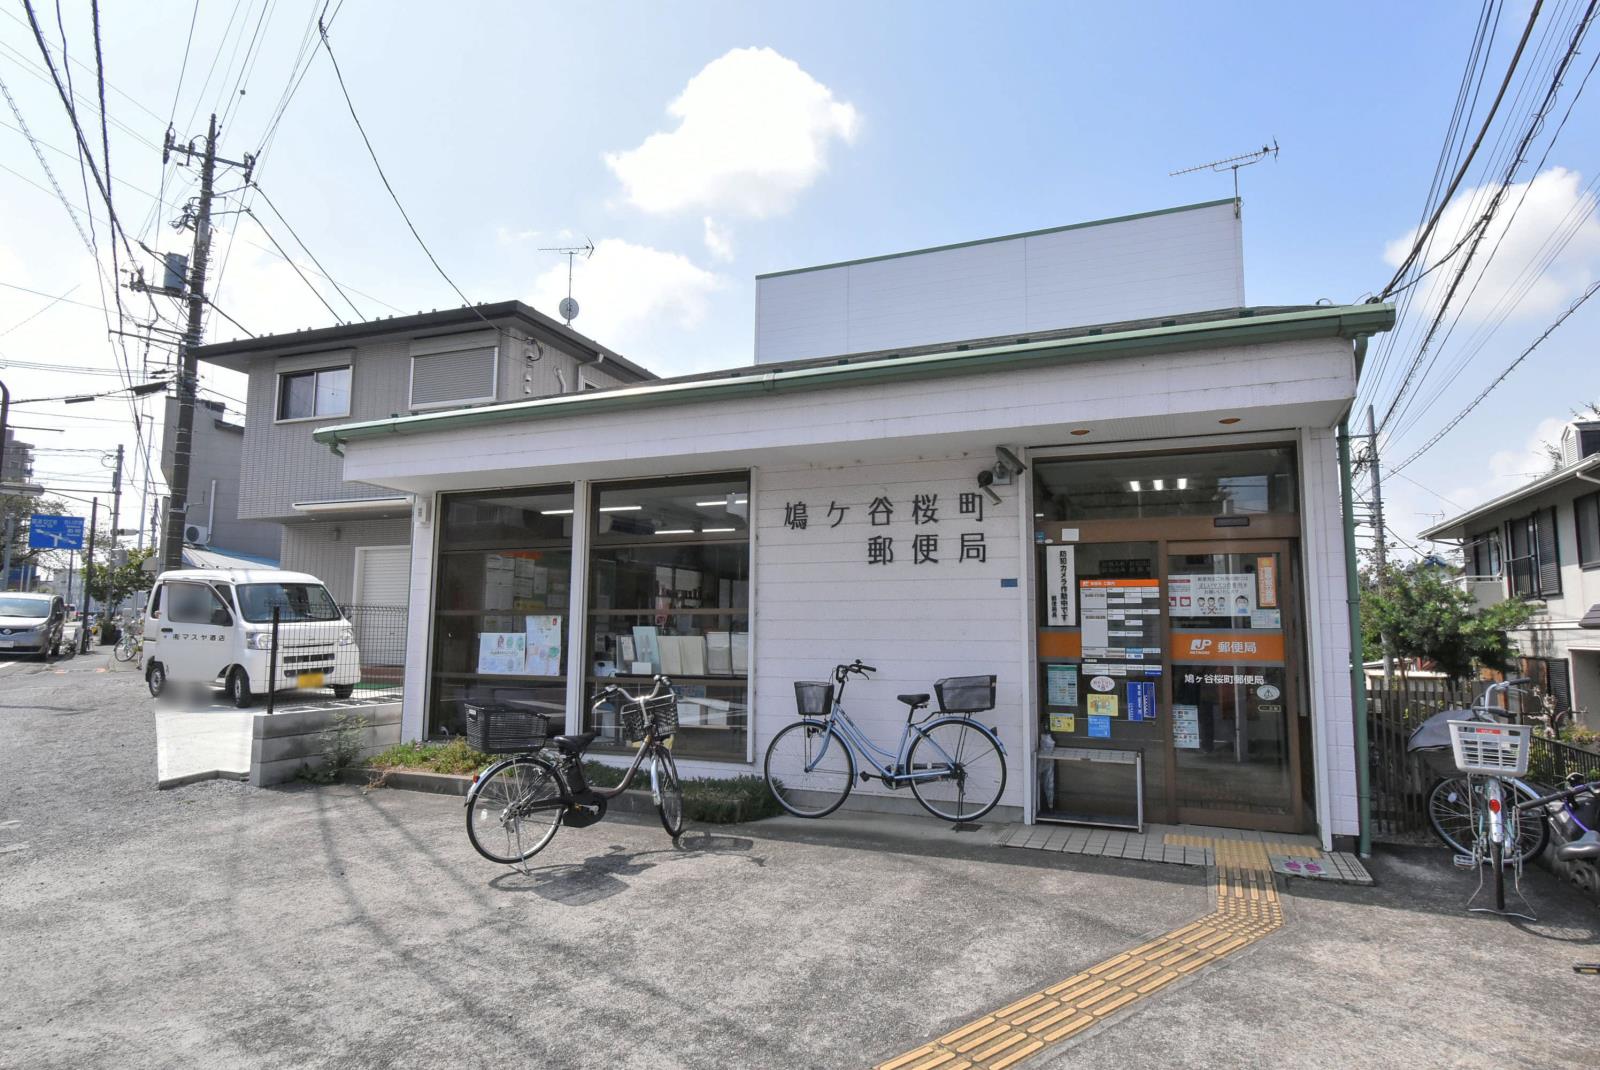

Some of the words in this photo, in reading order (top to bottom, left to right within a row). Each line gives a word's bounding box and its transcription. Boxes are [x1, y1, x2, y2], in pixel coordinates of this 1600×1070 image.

[867, 532, 987, 565] 郵便局
[1059, 550, 1068, 622] 防犯カメラ作動中です
[1217, 641, 1257, 654] 郵便局
